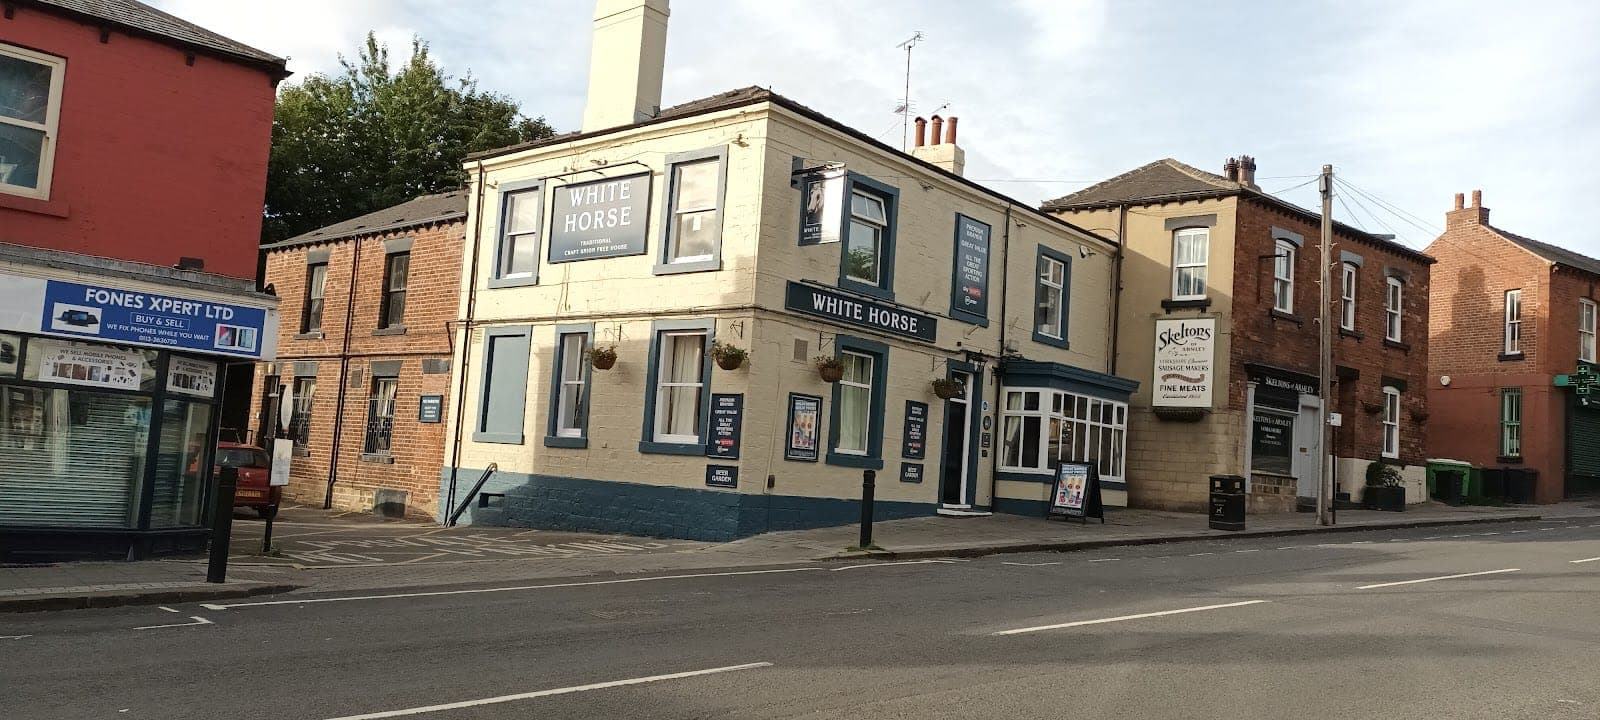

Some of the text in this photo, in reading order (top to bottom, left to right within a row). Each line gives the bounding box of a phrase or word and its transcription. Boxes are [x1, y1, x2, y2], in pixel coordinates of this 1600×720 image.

[570, 181, 632, 207] WHITE
[564, 206, 632, 232] HORSE
[86, 288, 234, 320] FONES XPERT LTD
[812, 292, 918, 333] WHITE HORSE
[130, 326, 156, 334] PHONES
[158, 329, 178, 337] WHILE
[135, 315, 154, 324] BUY
[165, 319, 184, 328] SELL
[1159, 323, 1210, 352] Skeltons
